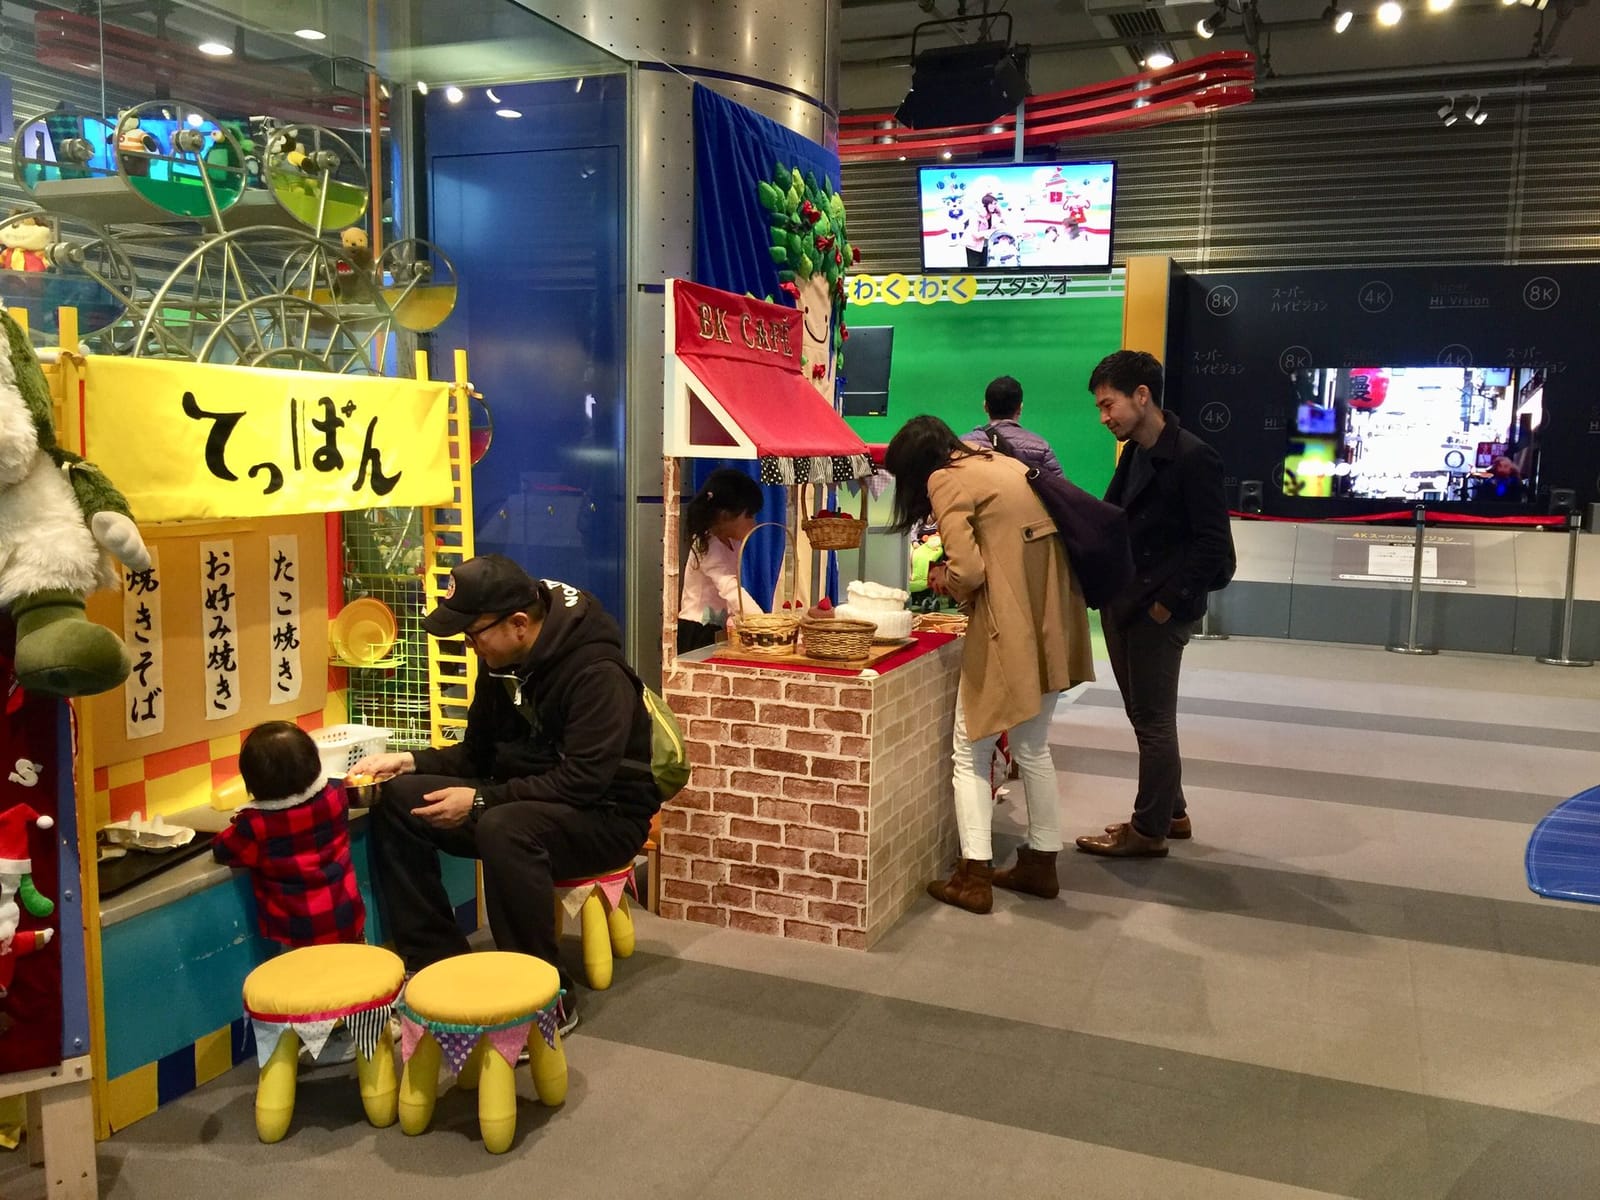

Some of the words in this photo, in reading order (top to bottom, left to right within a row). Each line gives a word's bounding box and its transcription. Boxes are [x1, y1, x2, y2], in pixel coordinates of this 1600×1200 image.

[853, 277, 968, 300] わくわく
[986, 274, 1072, 297] スタジオ
[1272, 285, 1305, 298] スーパー
[1529, 285, 1553, 301] 8K
[1211, 293, 1232, 309] 8K
[1364, 289, 1386, 304] 4K
[698, 303, 732, 344] BK
[1285, 354, 1305, 369] 8K
[1204, 410, 1225, 424] 4K
[273, 550, 300, 692] たこ焼き
[205, 550, 237, 710] お好み焼き
